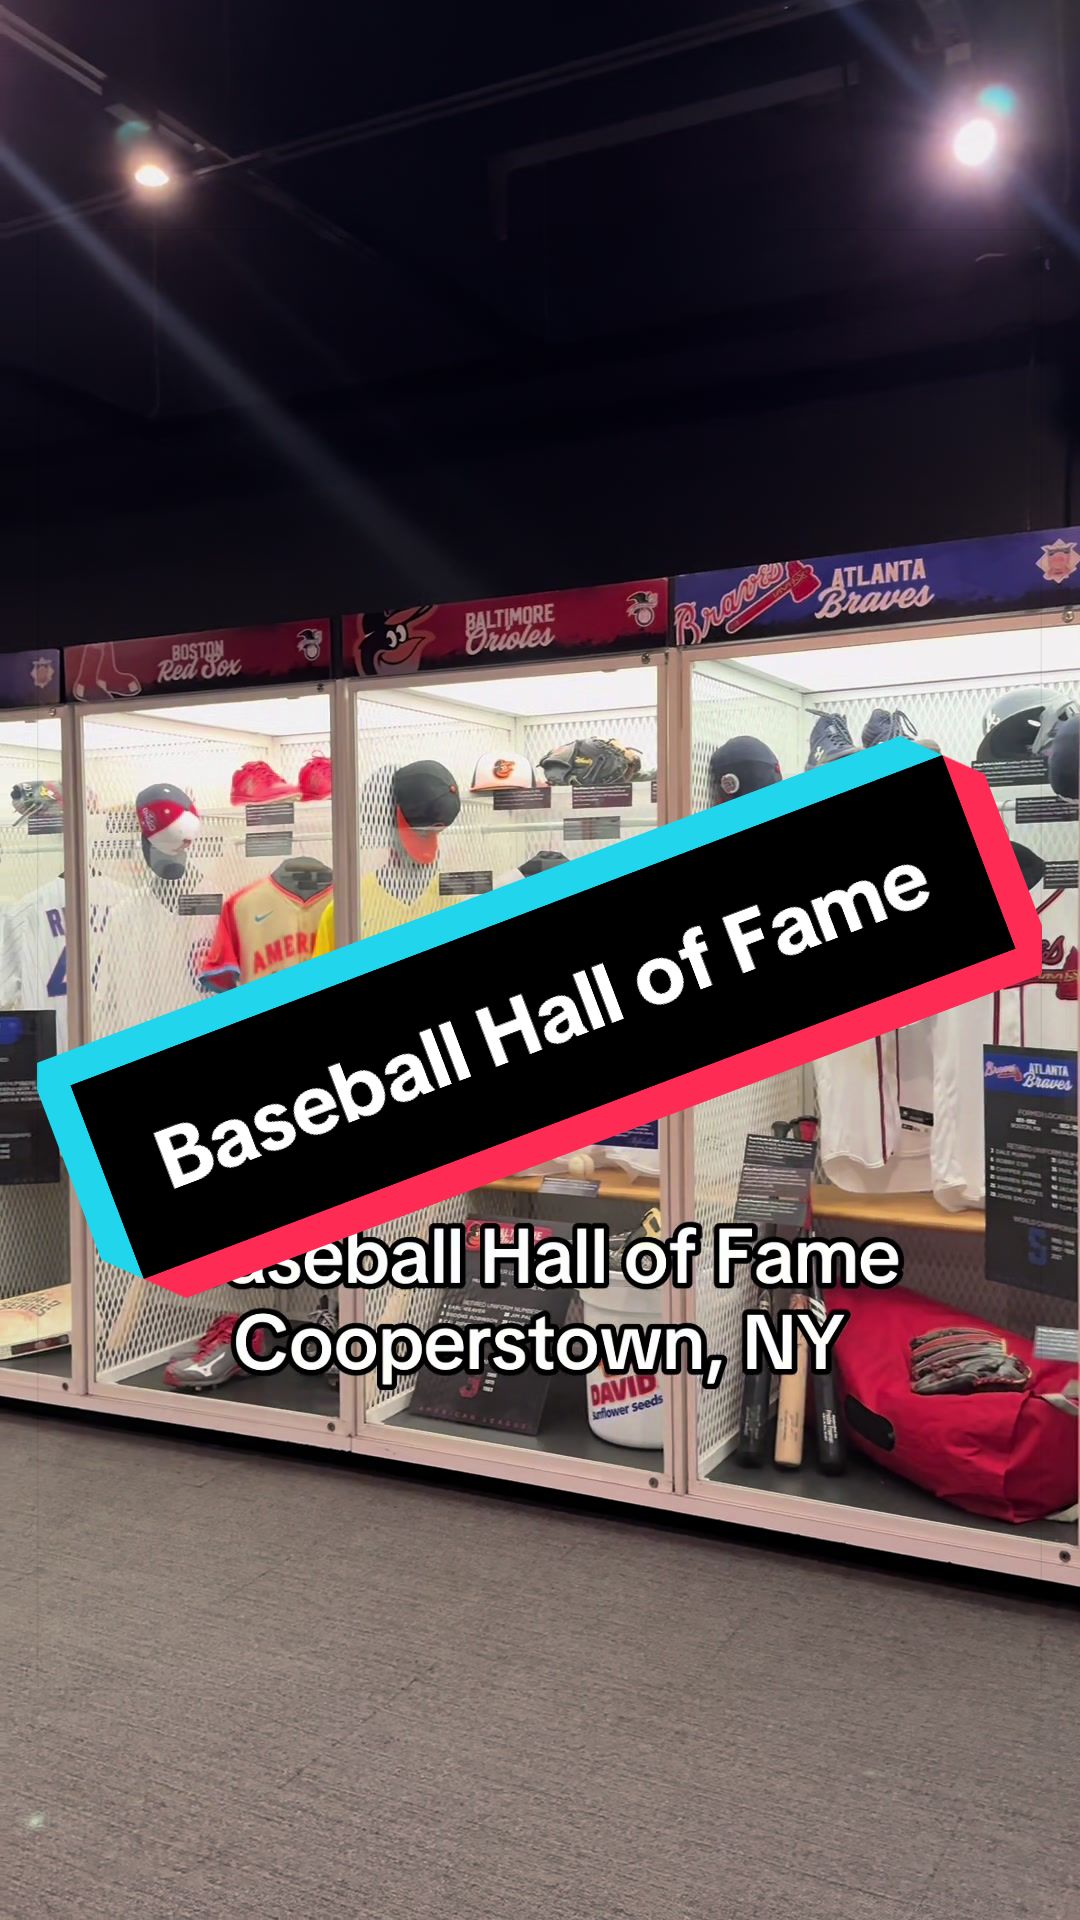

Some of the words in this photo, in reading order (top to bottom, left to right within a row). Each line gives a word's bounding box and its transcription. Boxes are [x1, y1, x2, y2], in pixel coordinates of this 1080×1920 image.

[831, 558, 927, 588] ATLANTA
[465, 603, 556, 630] BALTIMORE
[674, 561, 784, 646] Braves
[814, 584, 935, 619] Braves
[172, 639, 224, 662] BOSTON
[465, 623, 556, 655] Orioles
[157, 655, 199, 684] Red
[200, 653, 242, 679] Sox
[1022, 1072, 1073, 1091] Braves
[1029, 1062, 1069, 1077] ATLANTA
[590, 1374, 657, 1407] DAVID
